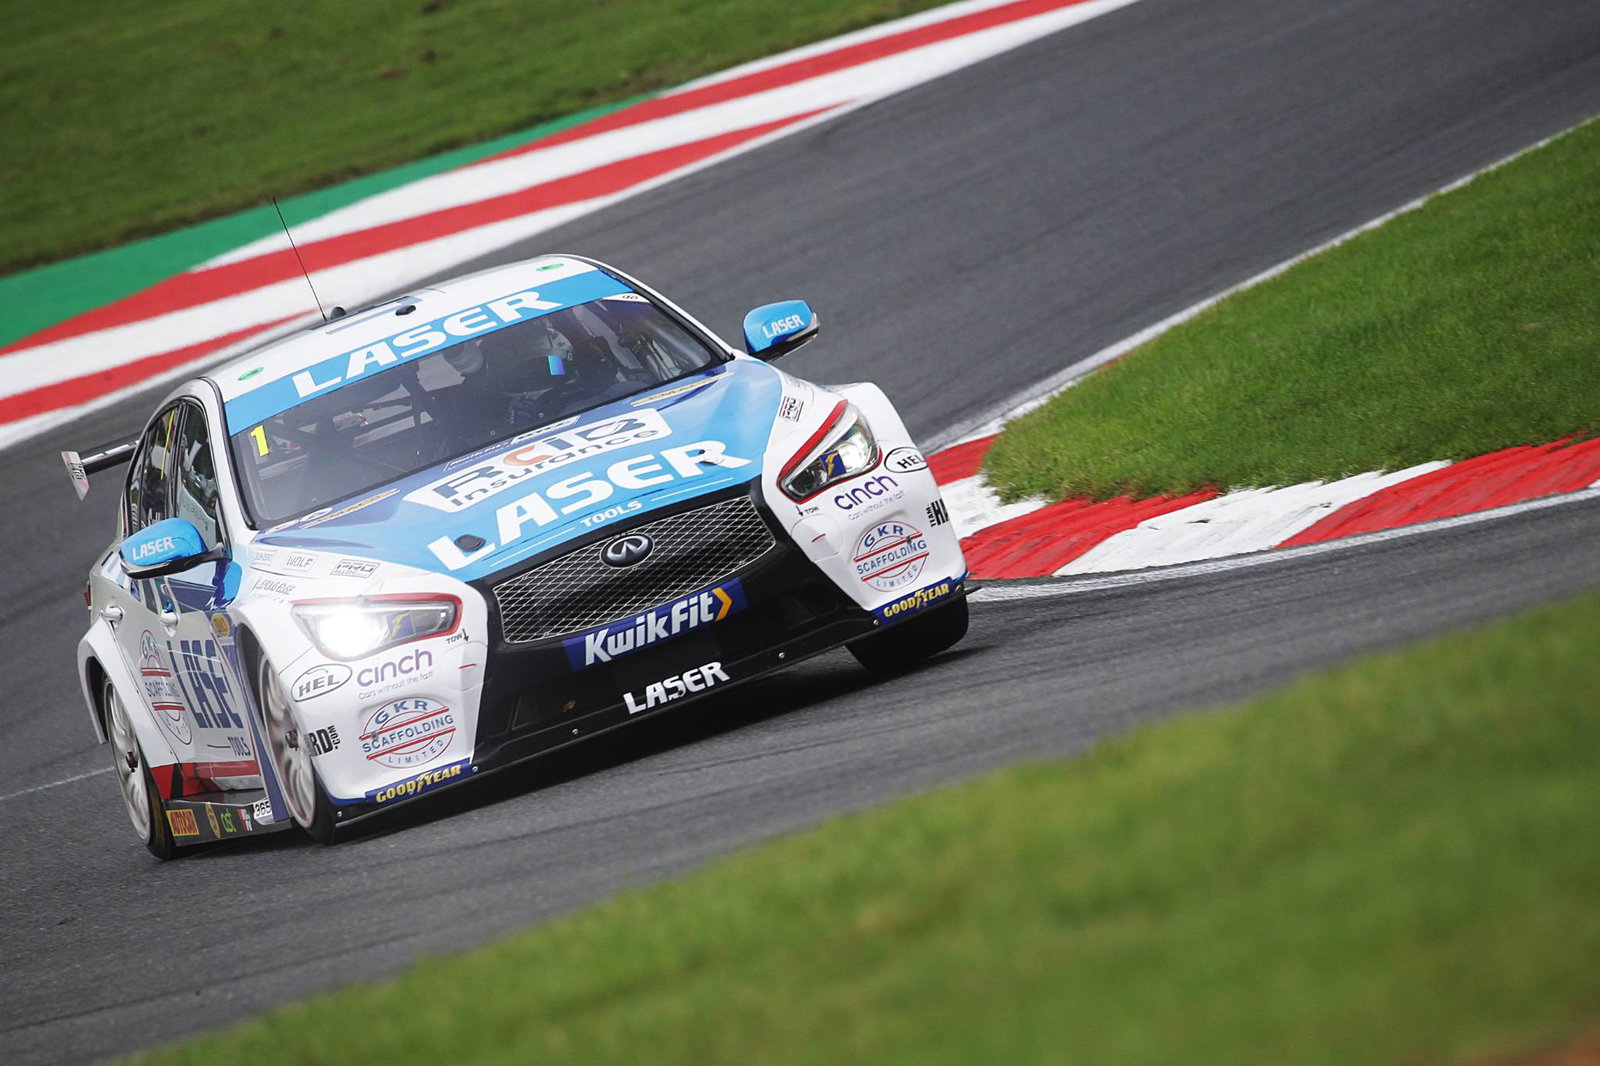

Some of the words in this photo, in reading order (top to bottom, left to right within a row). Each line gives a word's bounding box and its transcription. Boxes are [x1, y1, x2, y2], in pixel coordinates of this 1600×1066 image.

[762, 314, 805, 340] LASER
[291, 290, 563, 399] LASER
[250, 425, 270, 457] 1
[428, 439, 751, 571] LASER
[833, 474, 899, 511] cinch
[580, 501, 643, 528] TOOLS
[132, 537, 175, 561] LASER
[864, 525, 904, 549] GKR
[286, 555, 314, 569] WOLF
[856, 539, 927, 576] SCAFFOLDING
[876, 564, 918, 588] LIMITED
[883, 583, 950, 618] GOODYEAR
[357, 649, 433, 687] cinch
[298, 677, 342, 697] HEL
[624, 661, 729, 715] LASER
[374, 699, 429, 725] GKR
[362, 714, 454, 753] SCAFFOLDING
[388, 739, 445, 763] LIMITED
[376, 764, 462, 804] GOODYEAR
[254, 800, 272, 818] 365
